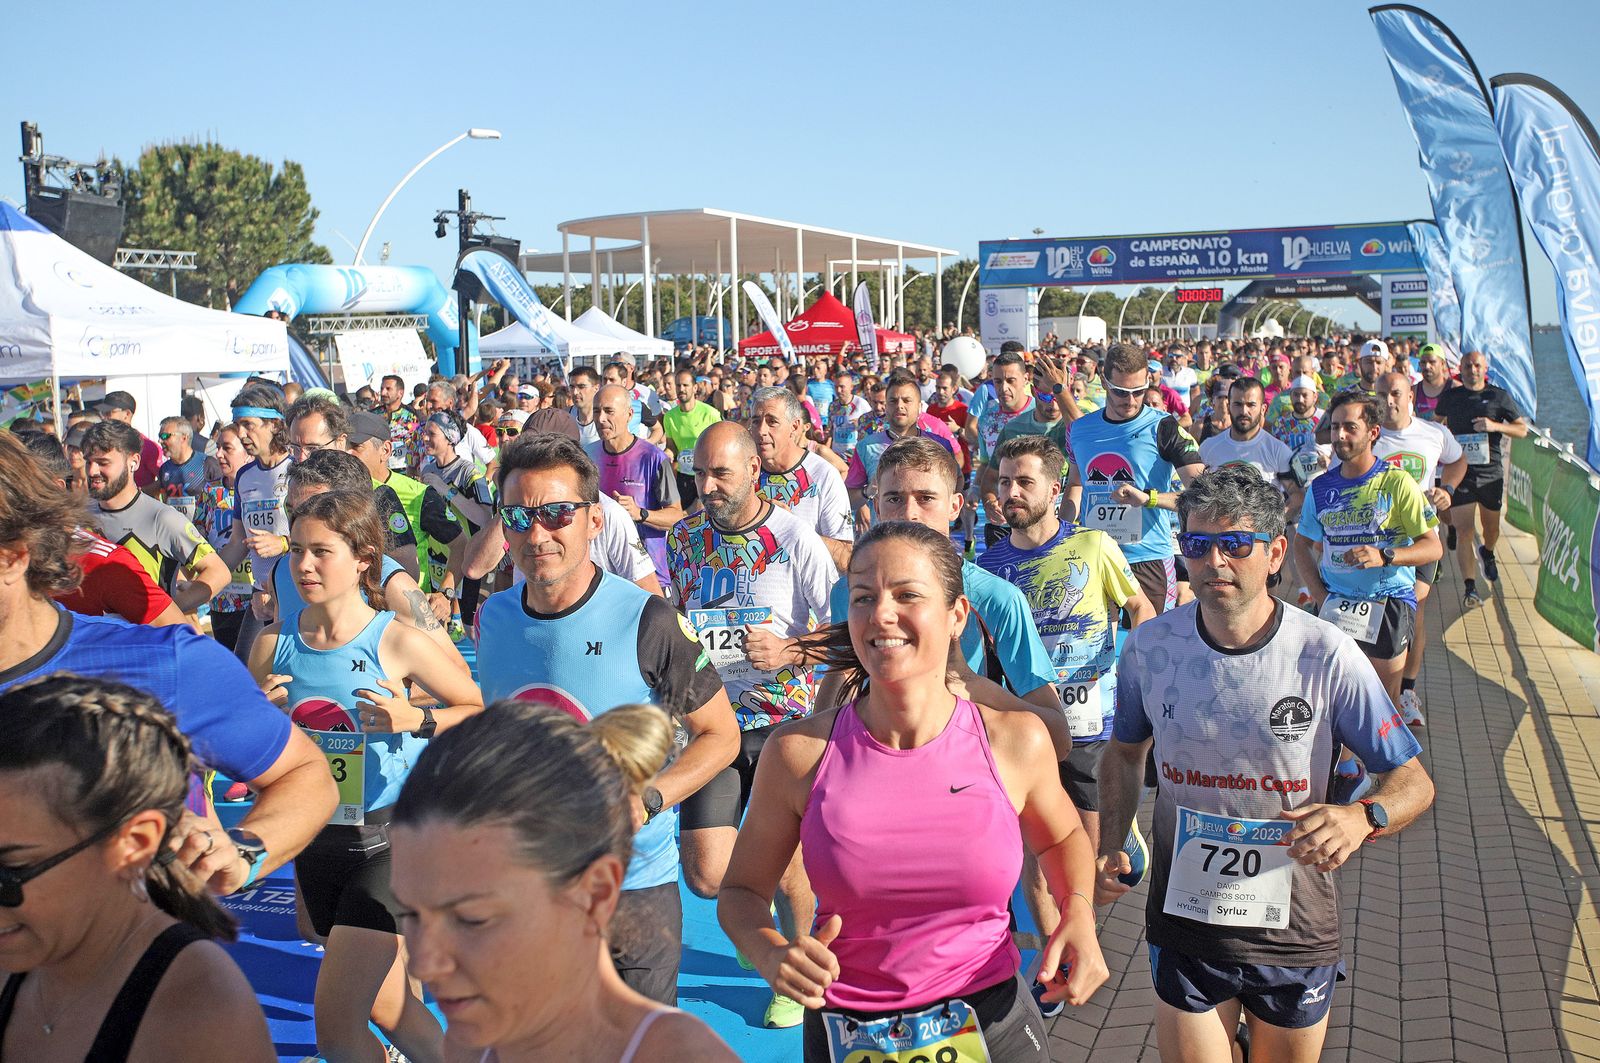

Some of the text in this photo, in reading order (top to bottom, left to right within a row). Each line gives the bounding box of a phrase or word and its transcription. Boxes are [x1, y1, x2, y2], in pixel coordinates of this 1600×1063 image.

[1130, 236, 1232, 252] CAMPEONATO
[1309, 240, 1352, 256] HUELVA
[1129, 248, 1268, 267] de ESPAÑA 10 km
[1196, 266, 1231, 275] Absoluto
[1240, 265, 1268, 274] Master
[744, 344, 831, 357] SPORTANIACS
[247, 512, 274, 527] 1815
[1097, 506, 1127, 521] 977
[736, 570, 757, 582] HU
[736, 582, 756, 595] EL
[736, 594, 755, 607] VA
[1339, 600, 1369, 616] 819
[743, 611, 766, 622] 2023
[1073, 669, 1093, 681] 2023
[1270, 699, 1296, 720] Maratón
[327, 737, 355, 750] 2023
[331, 757, 347, 783] 3
[1186, 769, 1257, 792] Maratón
[1261, 775, 1308, 794] Cepsa
[1199, 821, 1224, 834] HUELVA
[1251, 827, 1283, 841] 2023
[1200, 843, 1262, 878] 720
[1216, 881, 1241, 891] DAVID
[1200, 888, 1256, 901] CAMPOS SOTO
[1216, 905, 1249, 917] Syrluz
[919, 1012, 962, 1041] 2023
